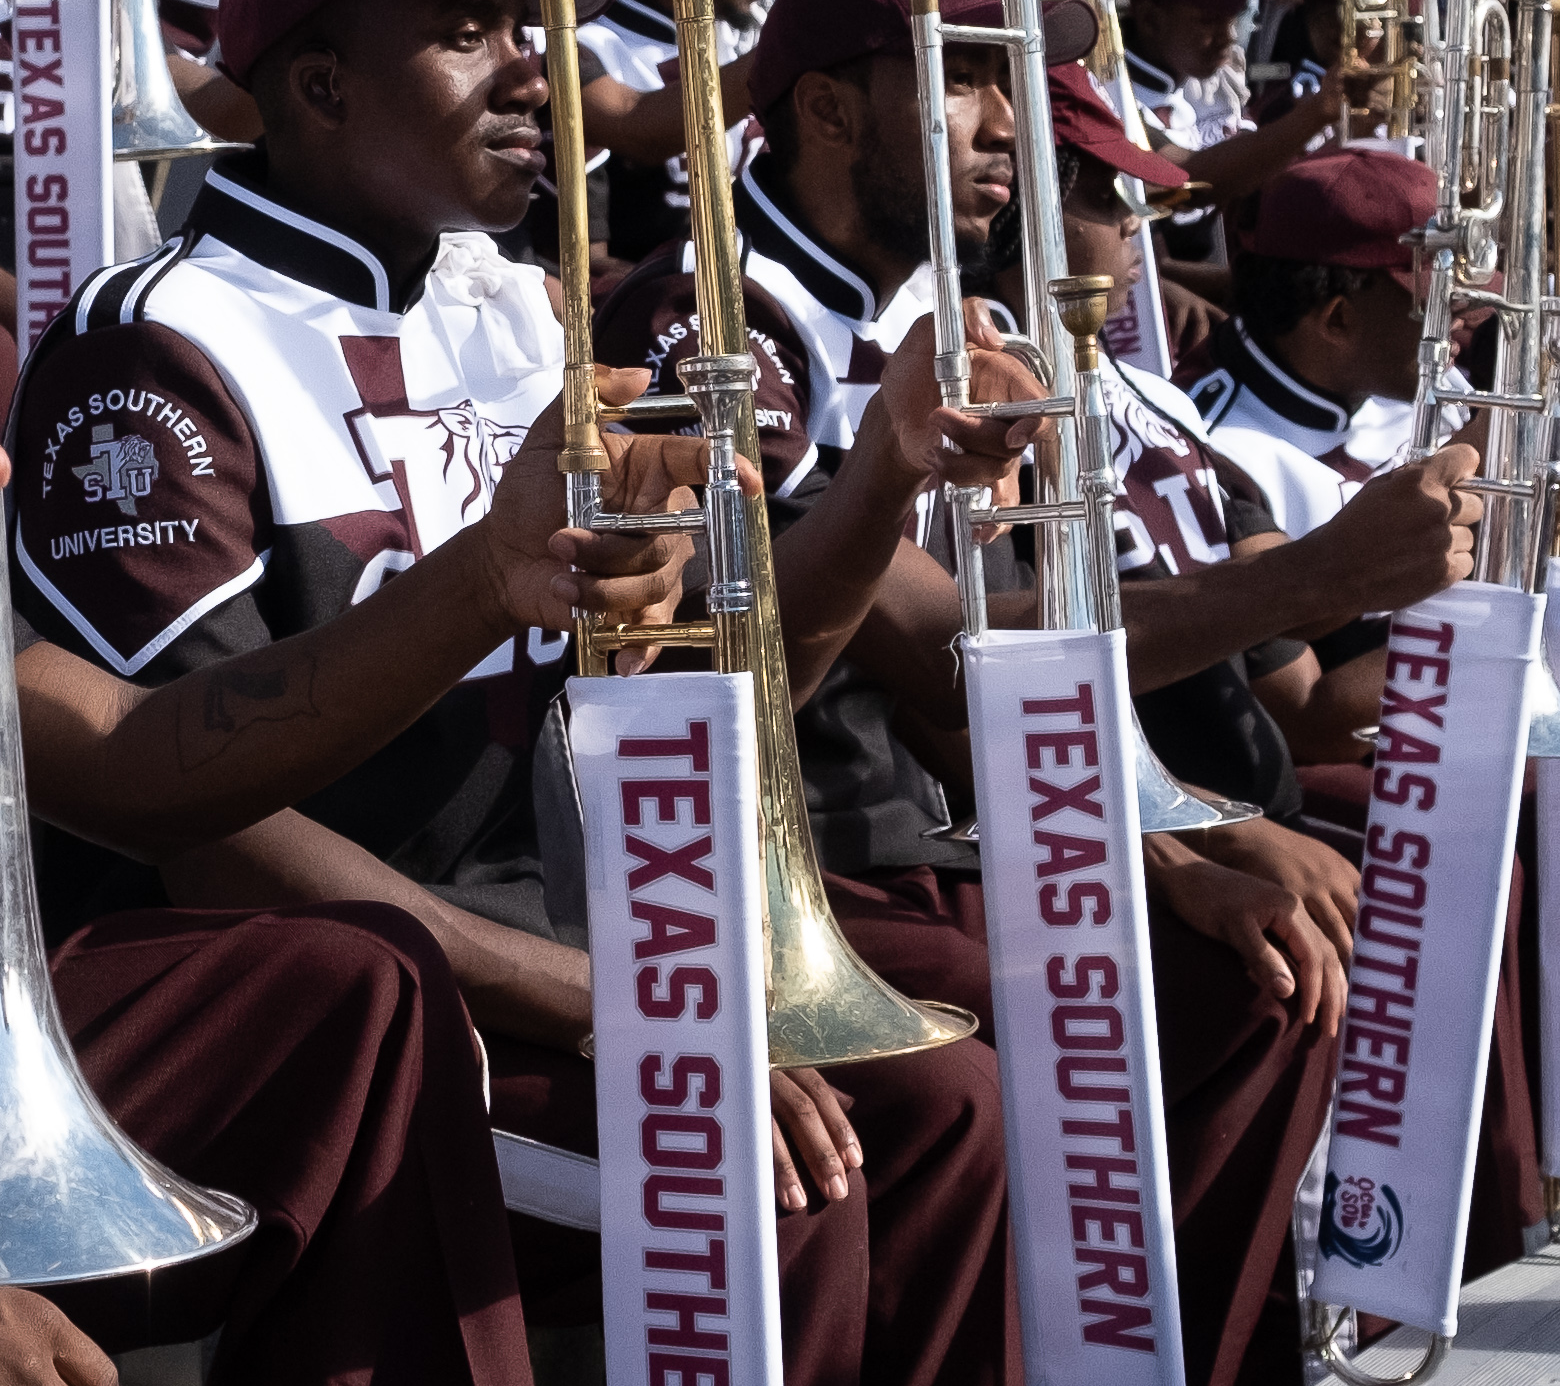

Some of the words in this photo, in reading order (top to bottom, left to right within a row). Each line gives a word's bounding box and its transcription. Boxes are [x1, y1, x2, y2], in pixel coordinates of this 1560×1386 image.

[17, 0, 67, 158] TEXAS
[43, 406, 84, 500] TEXAS
[88, 388, 217, 478] SOUTHERN
[50, 518, 200, 560] UNIVERSITY
[1021, 682, 1114, 929] TEXAS
[1374, 621, 1455, 813] TEXAS
[616, 719, 722, 1023] TEXAS
[1333, 823, 1433, 1149] SOUTHERN
[1043, 952, 1160, 1353] SOUTHERN
